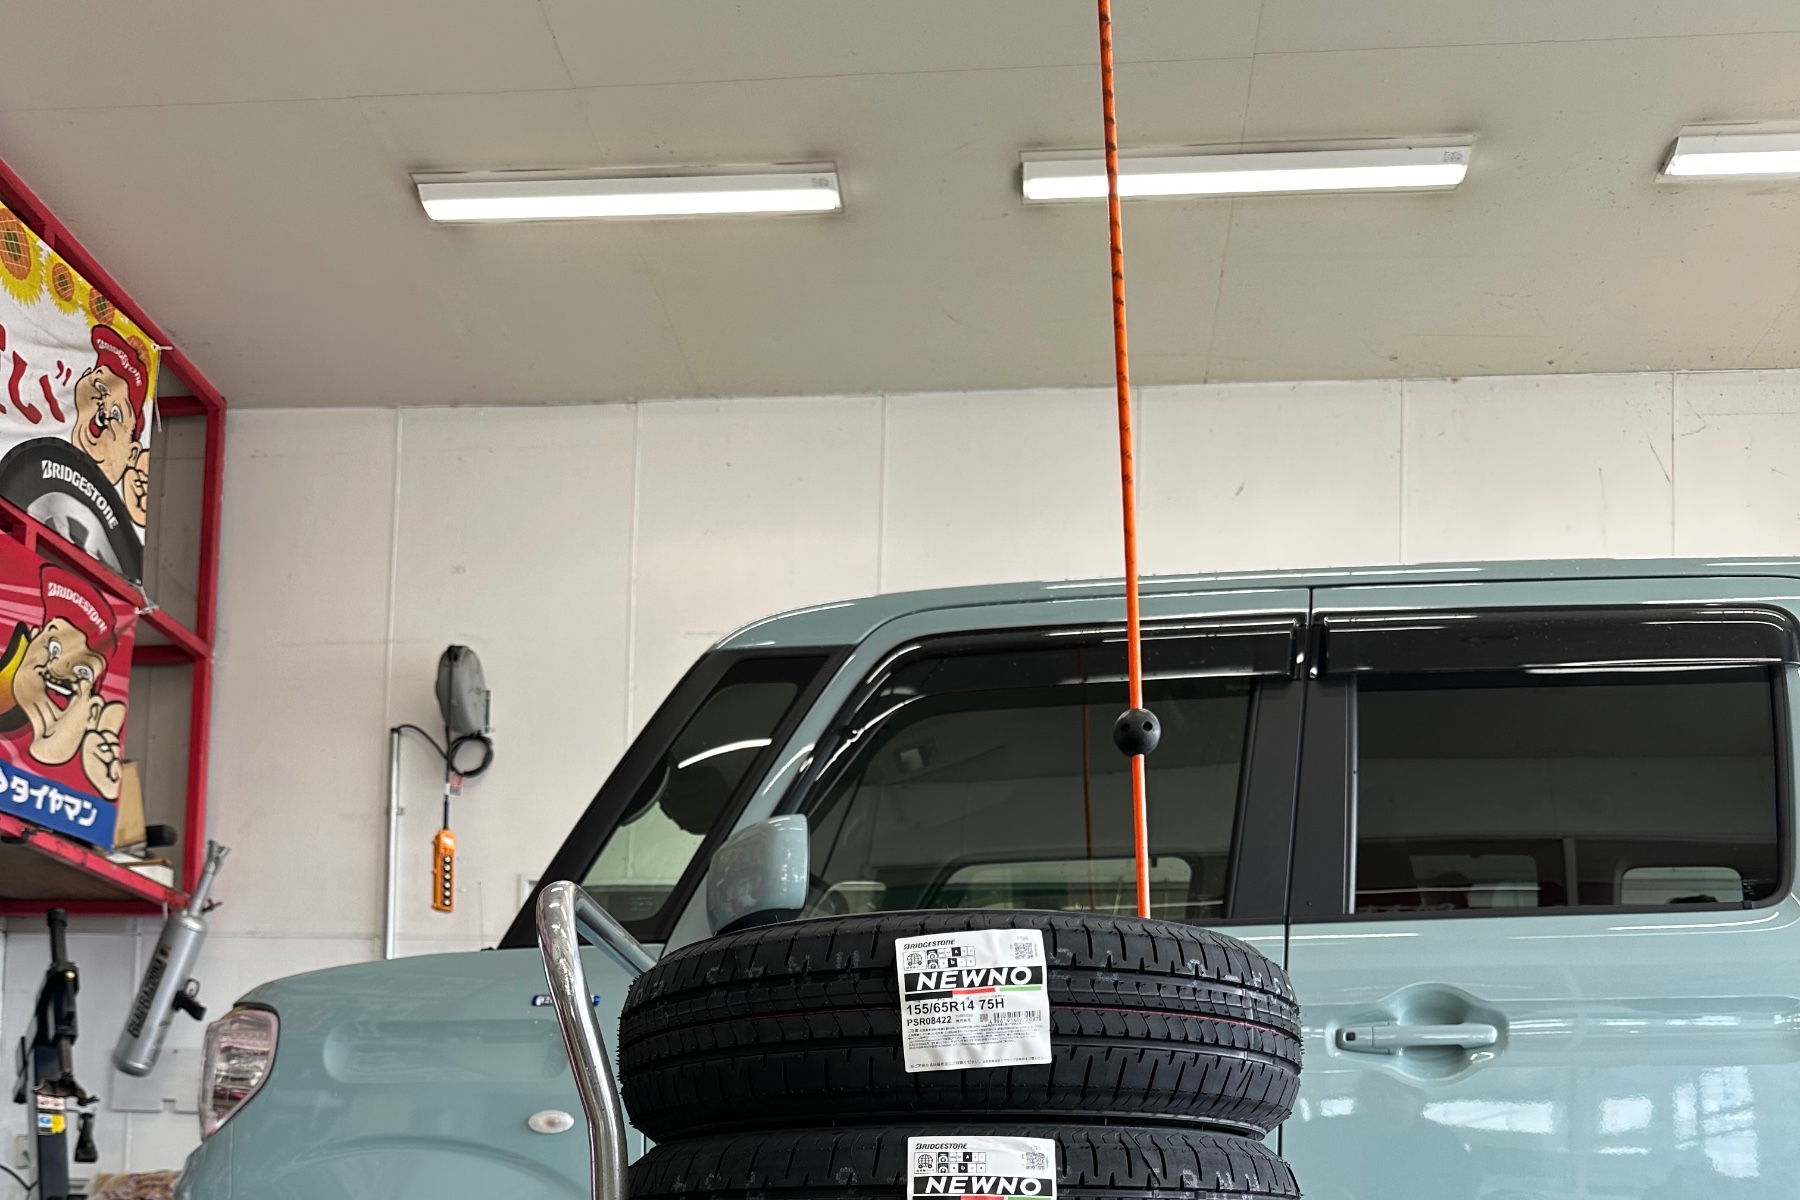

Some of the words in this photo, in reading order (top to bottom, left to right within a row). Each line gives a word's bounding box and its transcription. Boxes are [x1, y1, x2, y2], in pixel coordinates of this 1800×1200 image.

[96, 338, 143, 387] BRIDGESTONE
[41, 460, 118, 530] BRIDGESTONE
[47, 581, 108, 635] BRIDGESTONE
[903, 939, 956, 950] BRIDGESTONE
[916, 966, 1032, 991] NEWNO
[906, 1001, 975, 1015] 155/65R14
[979, 998, 1005, 1011] 75H
[906, 1015, 952, 1026] PSR08422
[915, 1142, 968, 1150] BRIDGESTONE
[925, 1176, 1042, 1196] NEWNO
